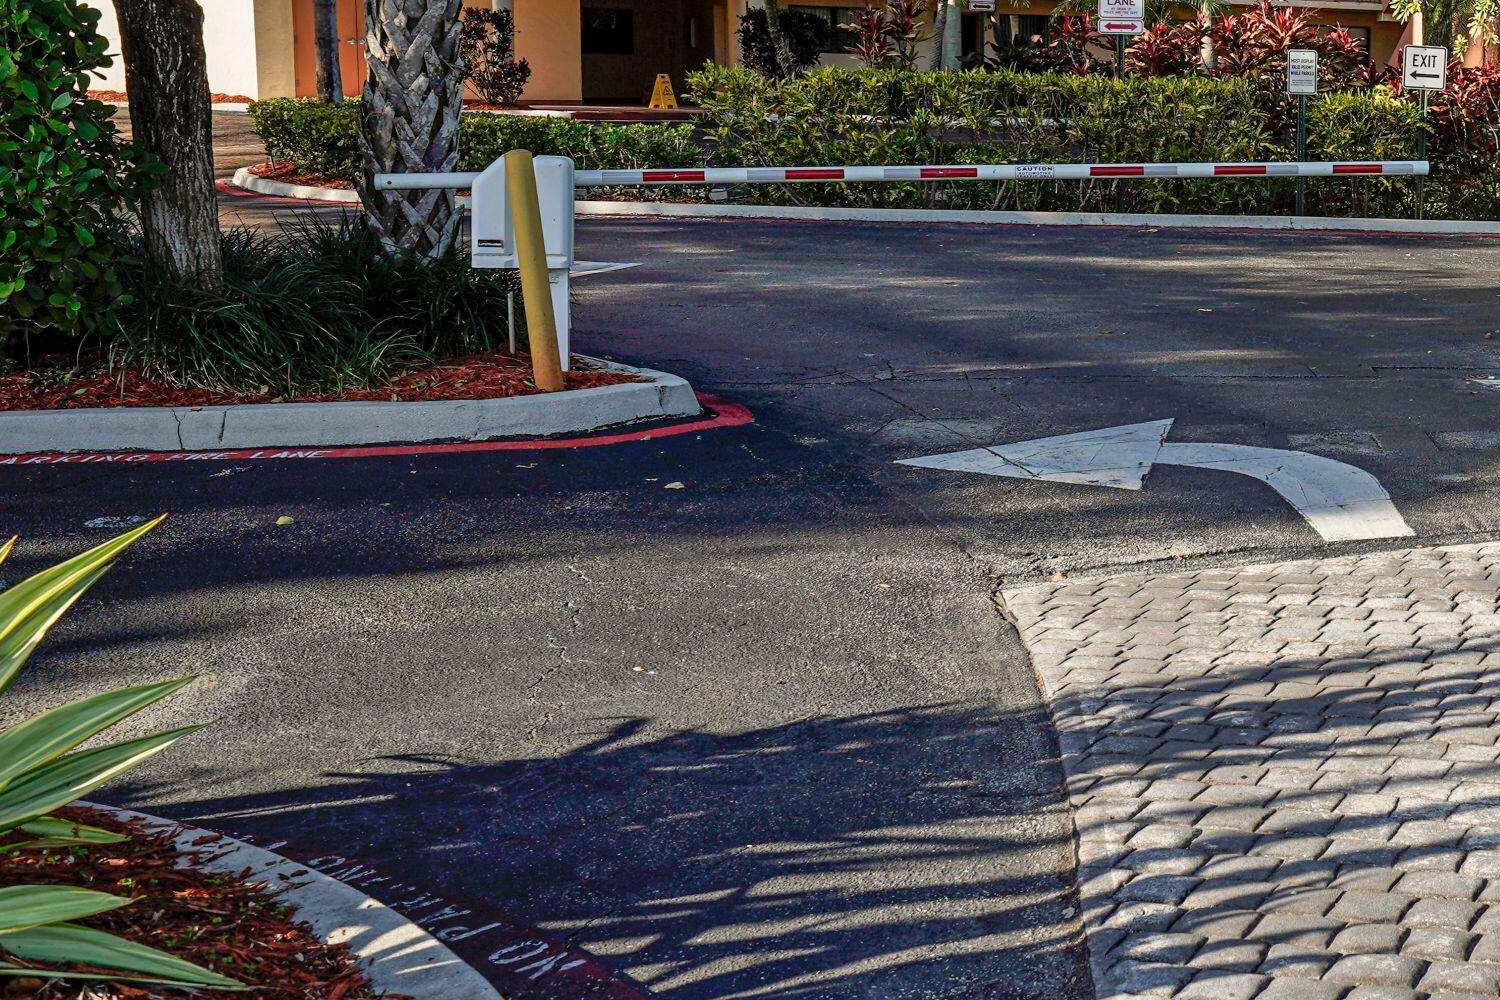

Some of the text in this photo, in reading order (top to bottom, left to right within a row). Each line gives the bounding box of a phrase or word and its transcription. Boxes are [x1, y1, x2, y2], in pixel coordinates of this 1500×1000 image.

[1412, 54, 1438, 68] EXIT
[164, 452, 239, 461] FIRE
[249, 450, 332, 460] LANE
[488, 939, 587, 981] NO
